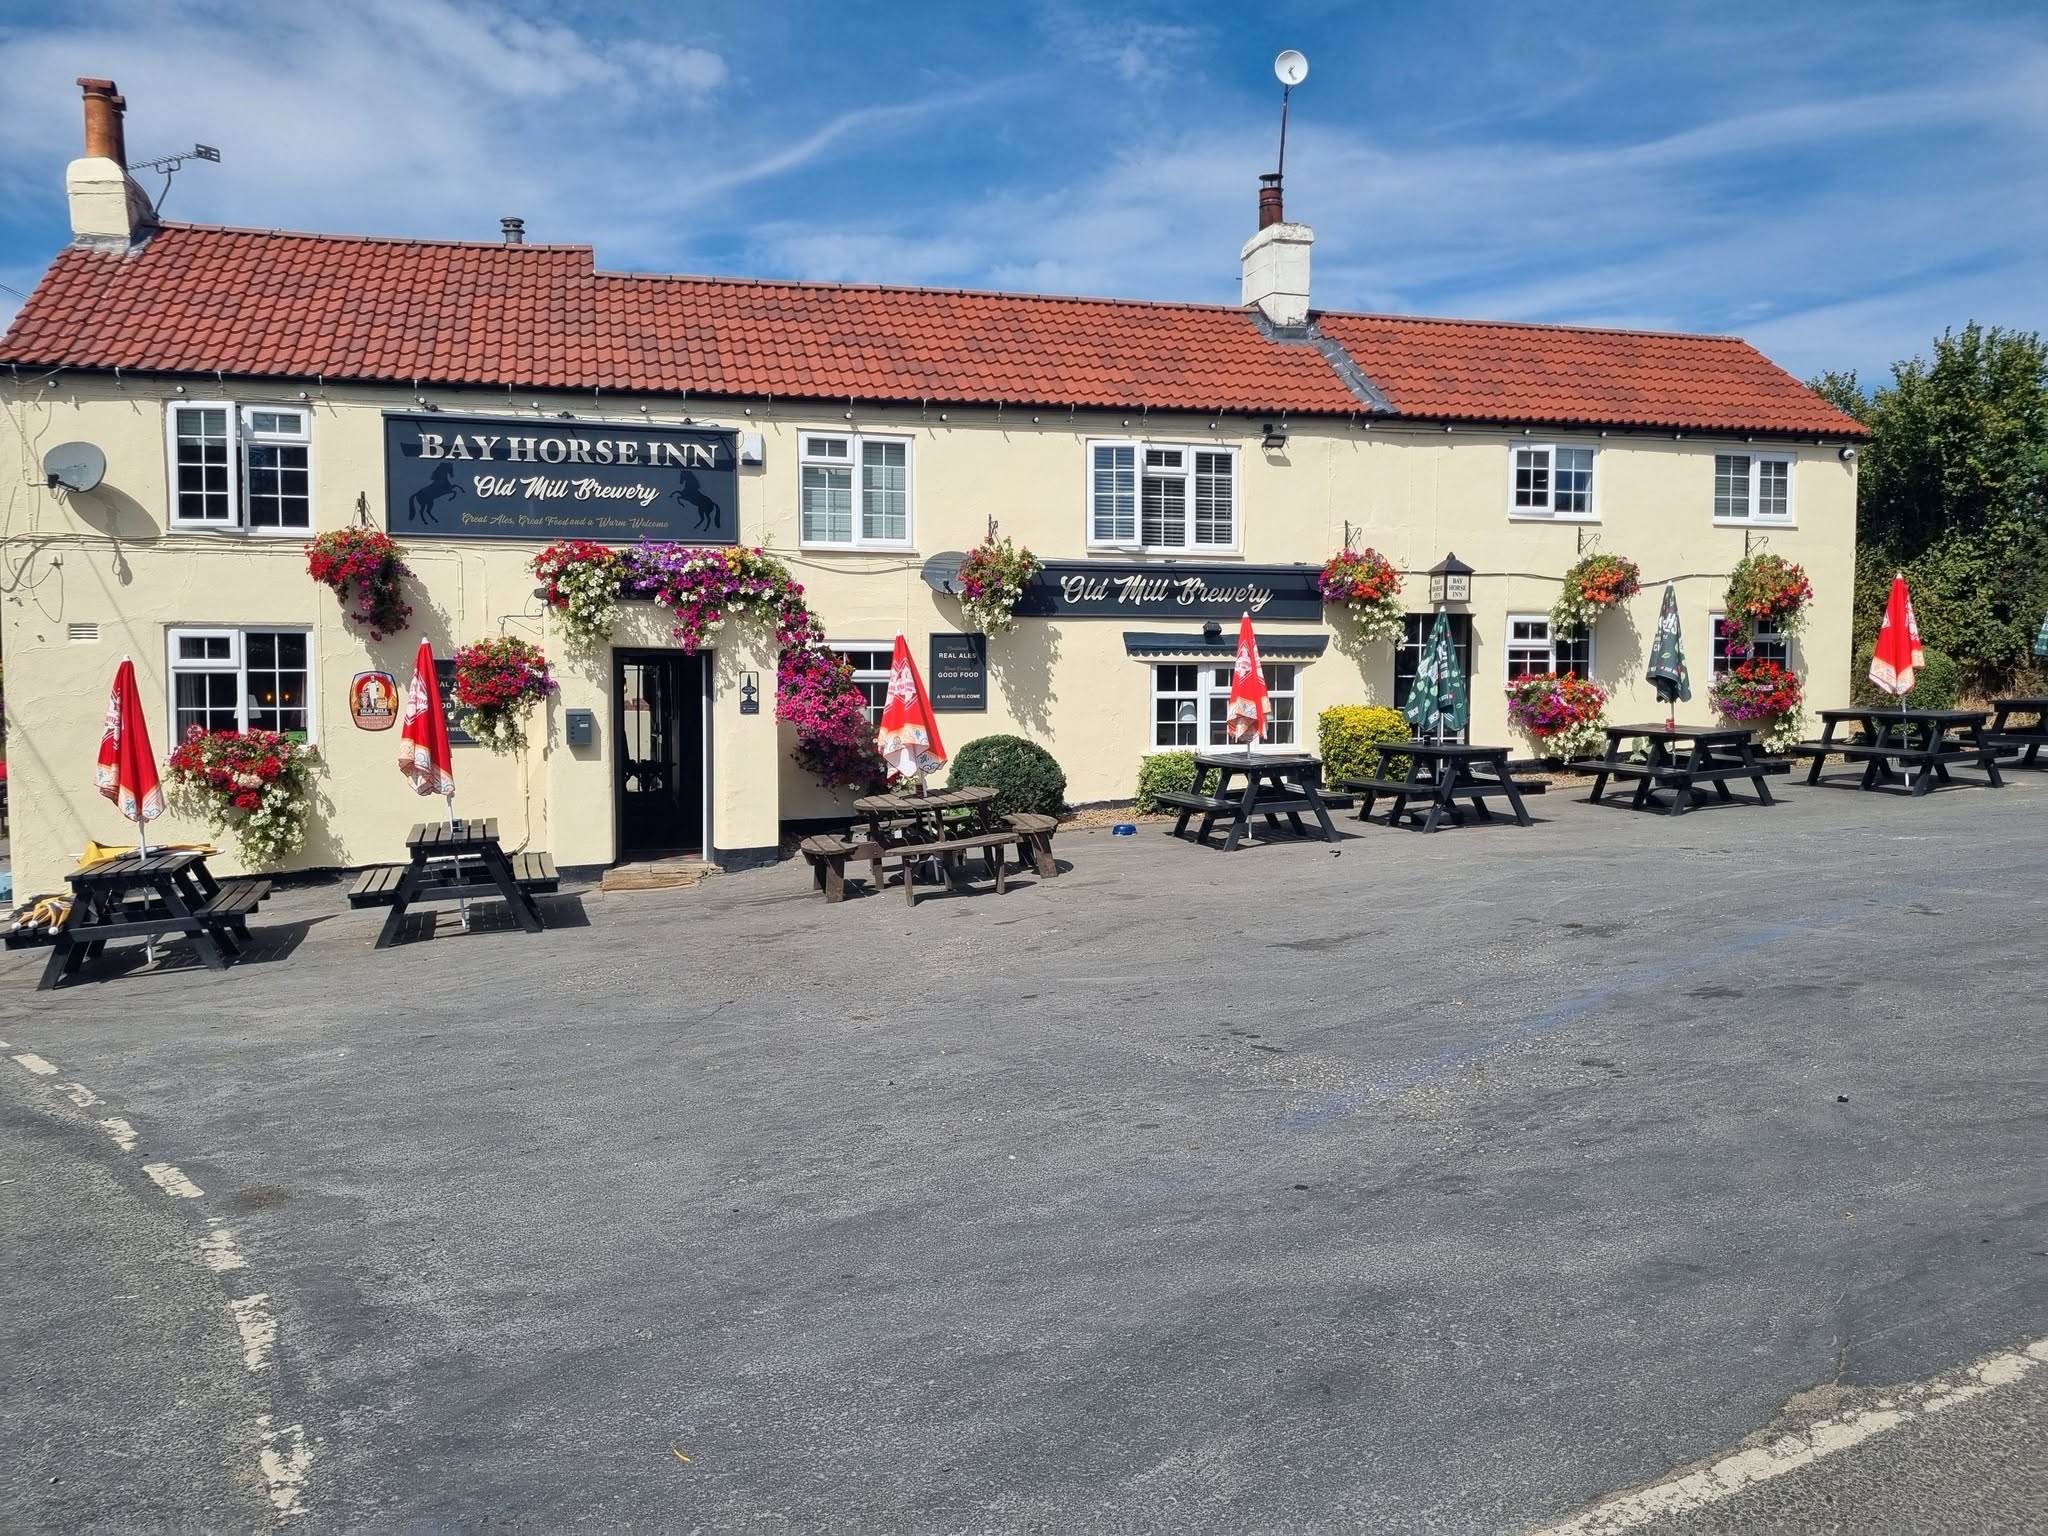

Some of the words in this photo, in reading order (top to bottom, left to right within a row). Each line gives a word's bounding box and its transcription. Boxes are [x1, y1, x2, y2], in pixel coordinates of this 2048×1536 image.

[418, 433, 500, 461] BAY
[507, 437, 639, 465] HORSE
[647, 442, 719, 468] INN
[473, 475, 517, 498] Old
[520, 476, 570, 500] Mill
[571, 478, 661, 507] Brewery
[462, 512, 488, 525] Great
[518, 513, 544, 526] Great
[545, 515, 570, 527] Food
[570, 517, 587, 527] and
[596, 517, 627, 528] Warm
[629, 517, 669, 529] Welcome
[1060, 575, 1109, 604] Old
[1113, 574, 1169, 606] Mill
[1173, 576, 1274, 614] Brewery
